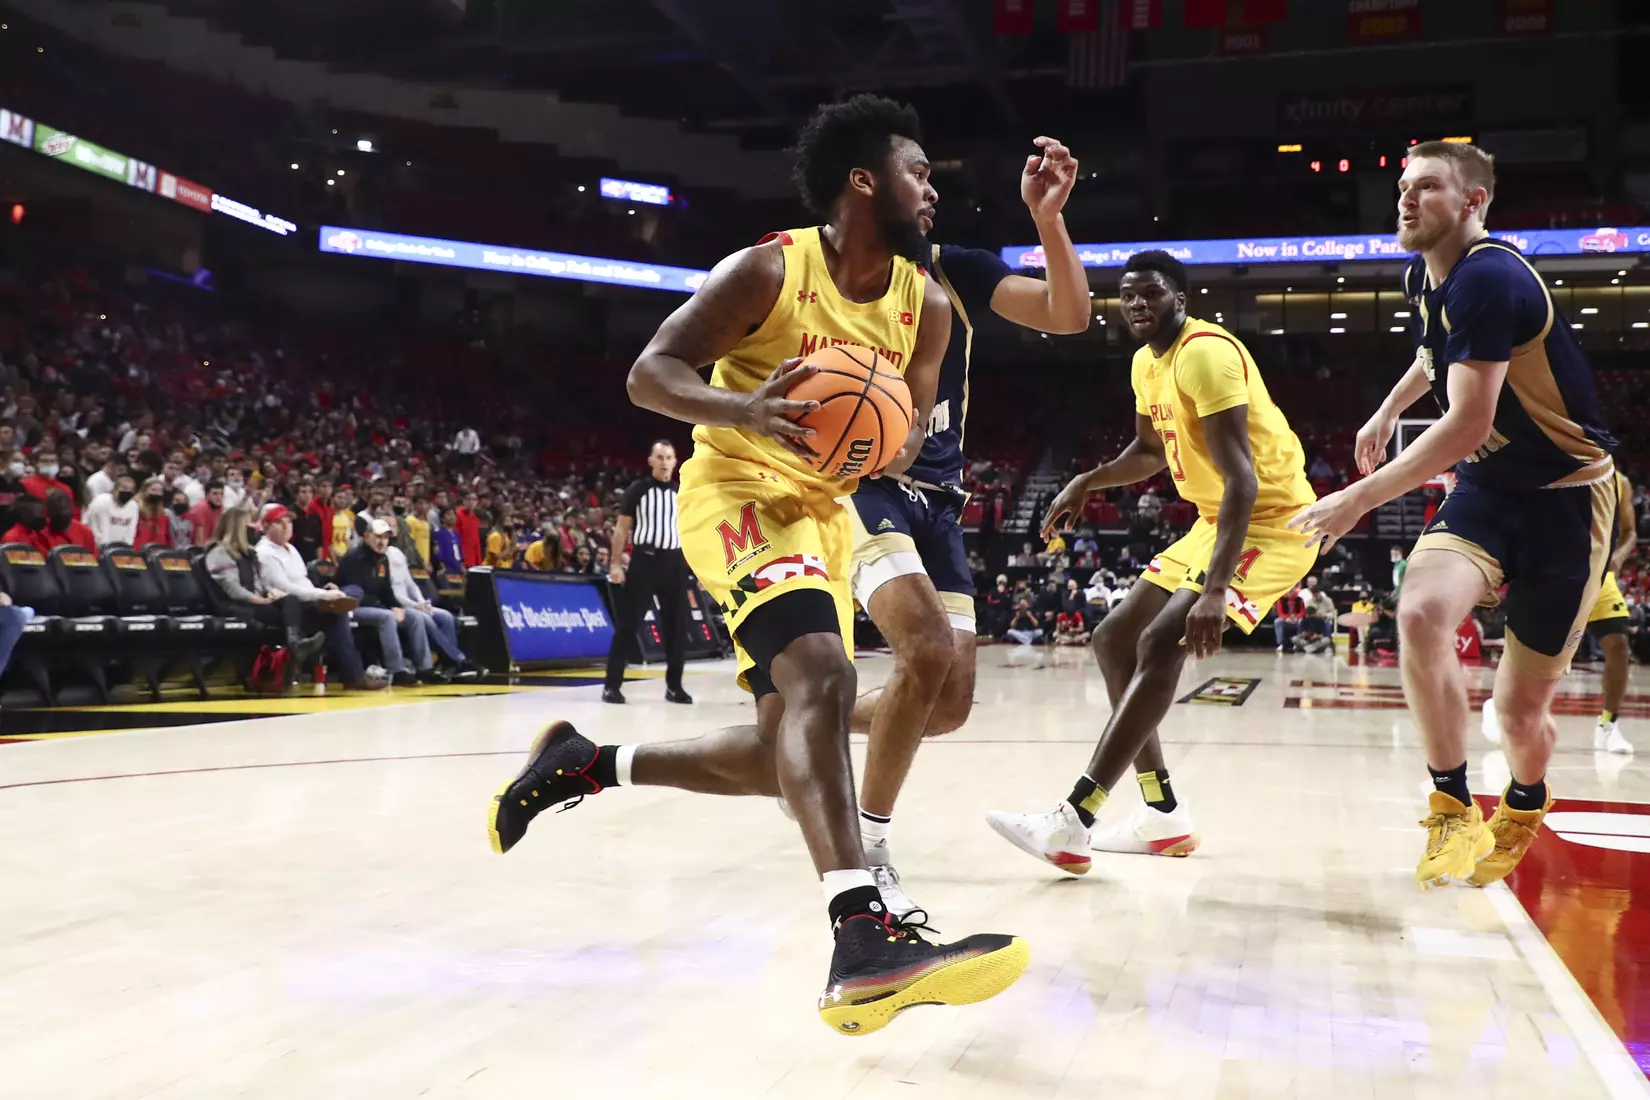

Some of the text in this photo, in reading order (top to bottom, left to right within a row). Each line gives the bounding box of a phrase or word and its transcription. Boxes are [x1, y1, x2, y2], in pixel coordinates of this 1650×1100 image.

[1237, 243, 1277, 258] Now
[1281, 242, 1298, 257] in
[1302, 240, 1365, 260] College
[715, 501, 769, 569] M
[502, 601, 608, 633] The Washington Post
